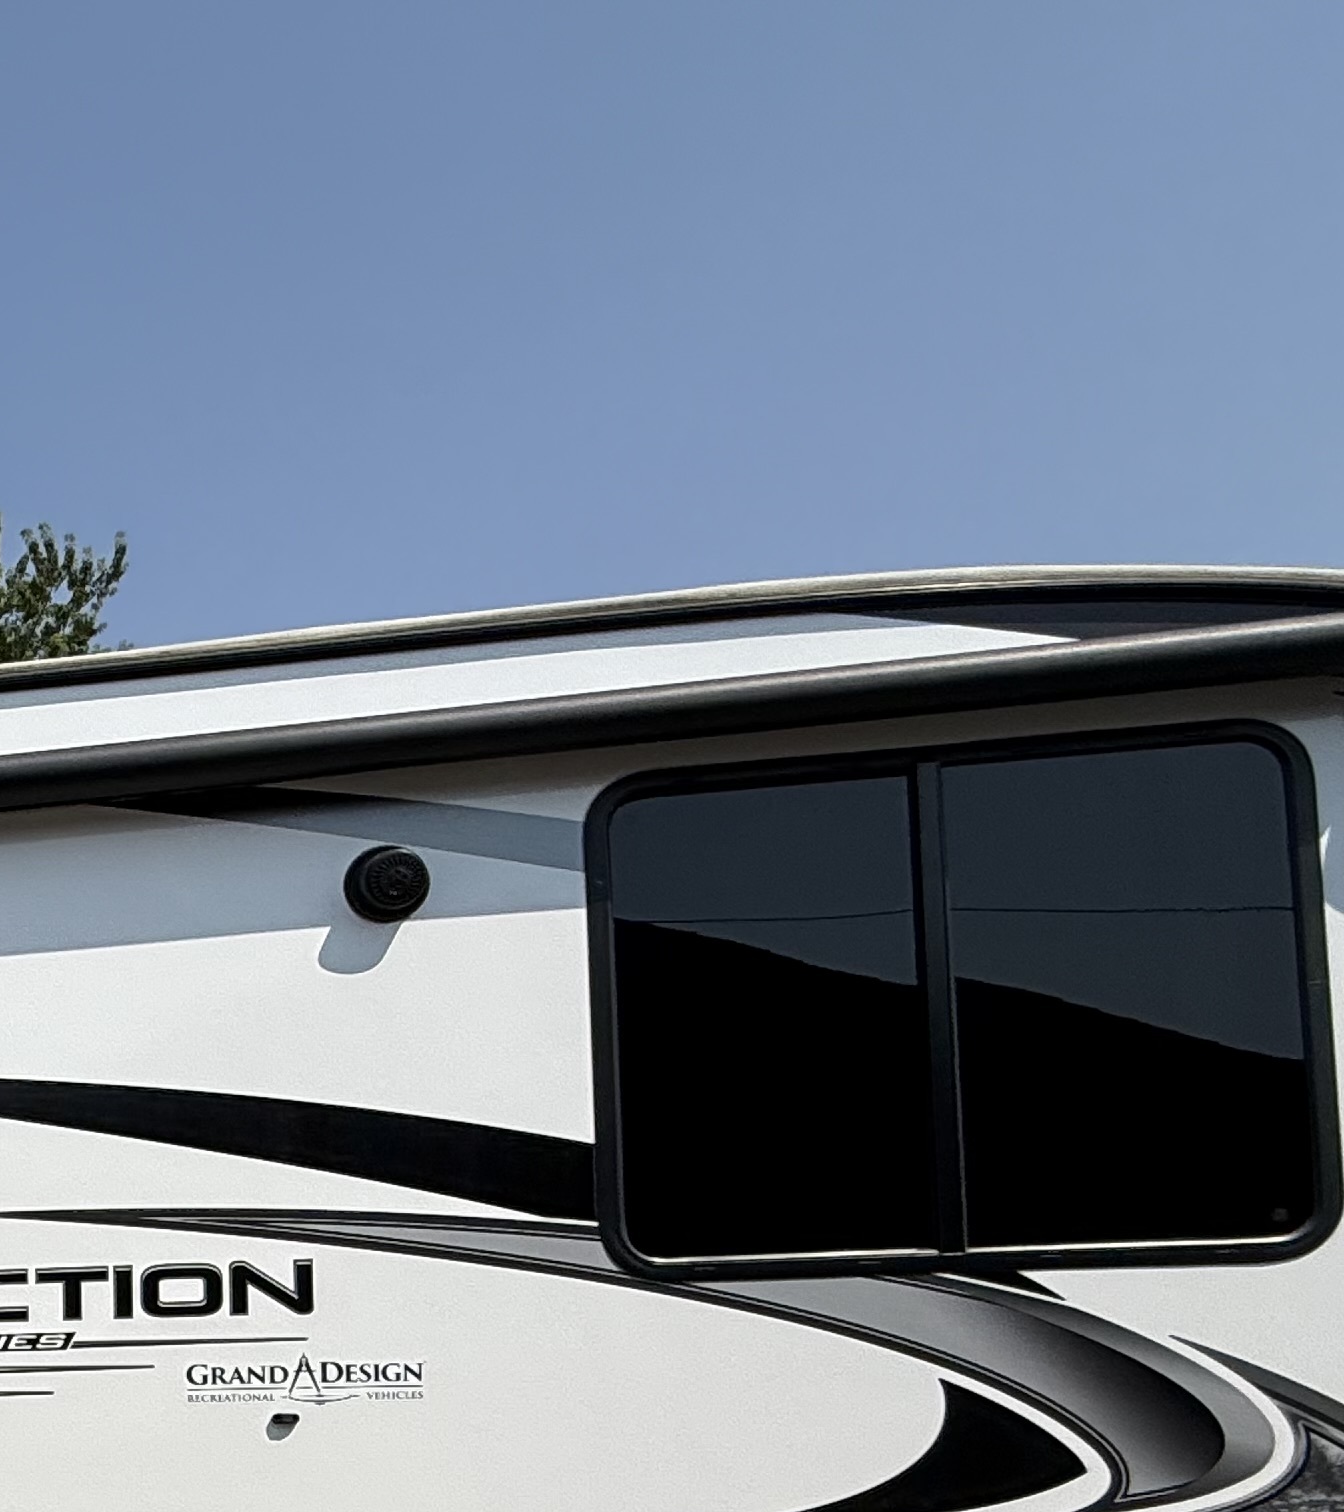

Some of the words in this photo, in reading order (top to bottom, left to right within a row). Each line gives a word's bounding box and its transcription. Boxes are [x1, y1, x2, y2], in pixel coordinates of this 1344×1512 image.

[185, 1363, 289, 1386] GRAND
[320, 1360, 424, 1383] DESIGN
[187, 1393, 276, 1403] RECREATIONAL
[366, 1390, 424, 1401] VEHICLES
